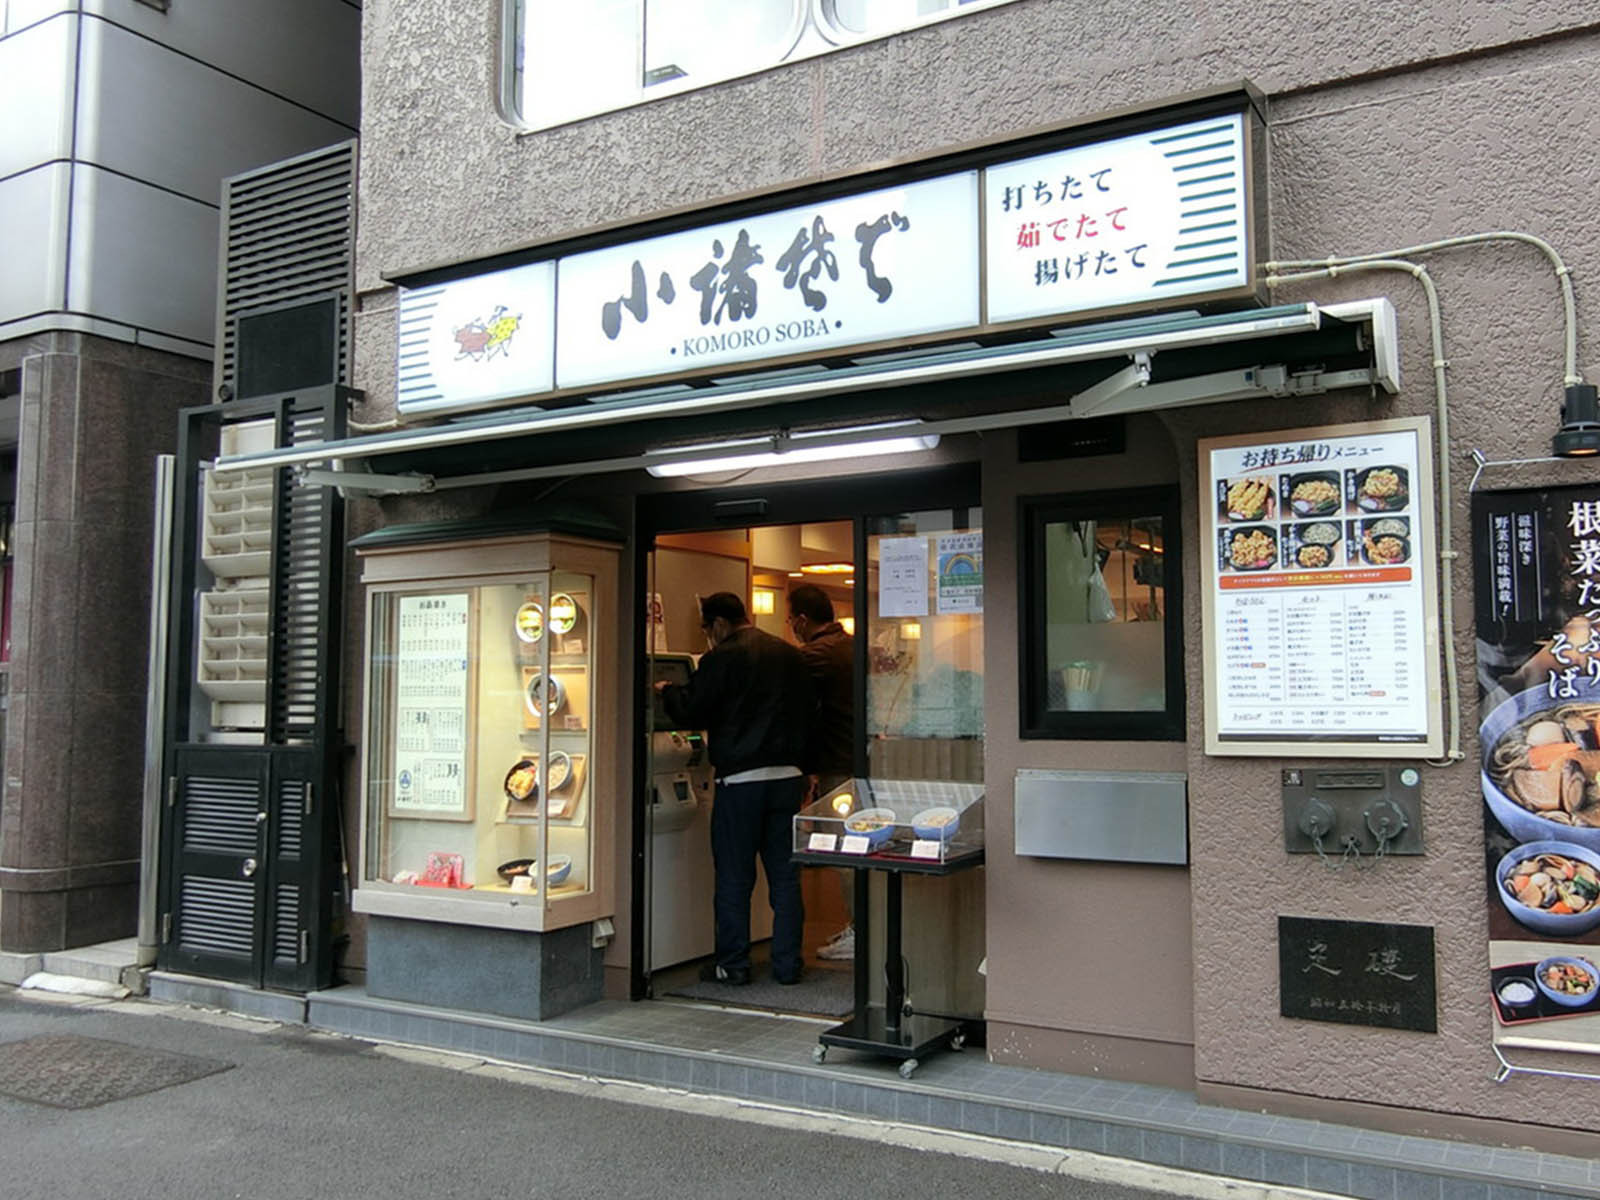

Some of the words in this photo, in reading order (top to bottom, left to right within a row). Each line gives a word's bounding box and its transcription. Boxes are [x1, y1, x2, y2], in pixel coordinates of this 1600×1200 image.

[1002, 168, 1112, 212] 打ちたて
[1017, 207, 1128, 251] 茹でたて
[1035, 244, 1147, 286] 揚げたて
[683, 326, 770, 356] KOMORO
[775, 318, 830, 342] SOBA
[1242, 444, 1384, 467] お持ち帰りメニュー
[1548, 632, 1580, 698] そば
